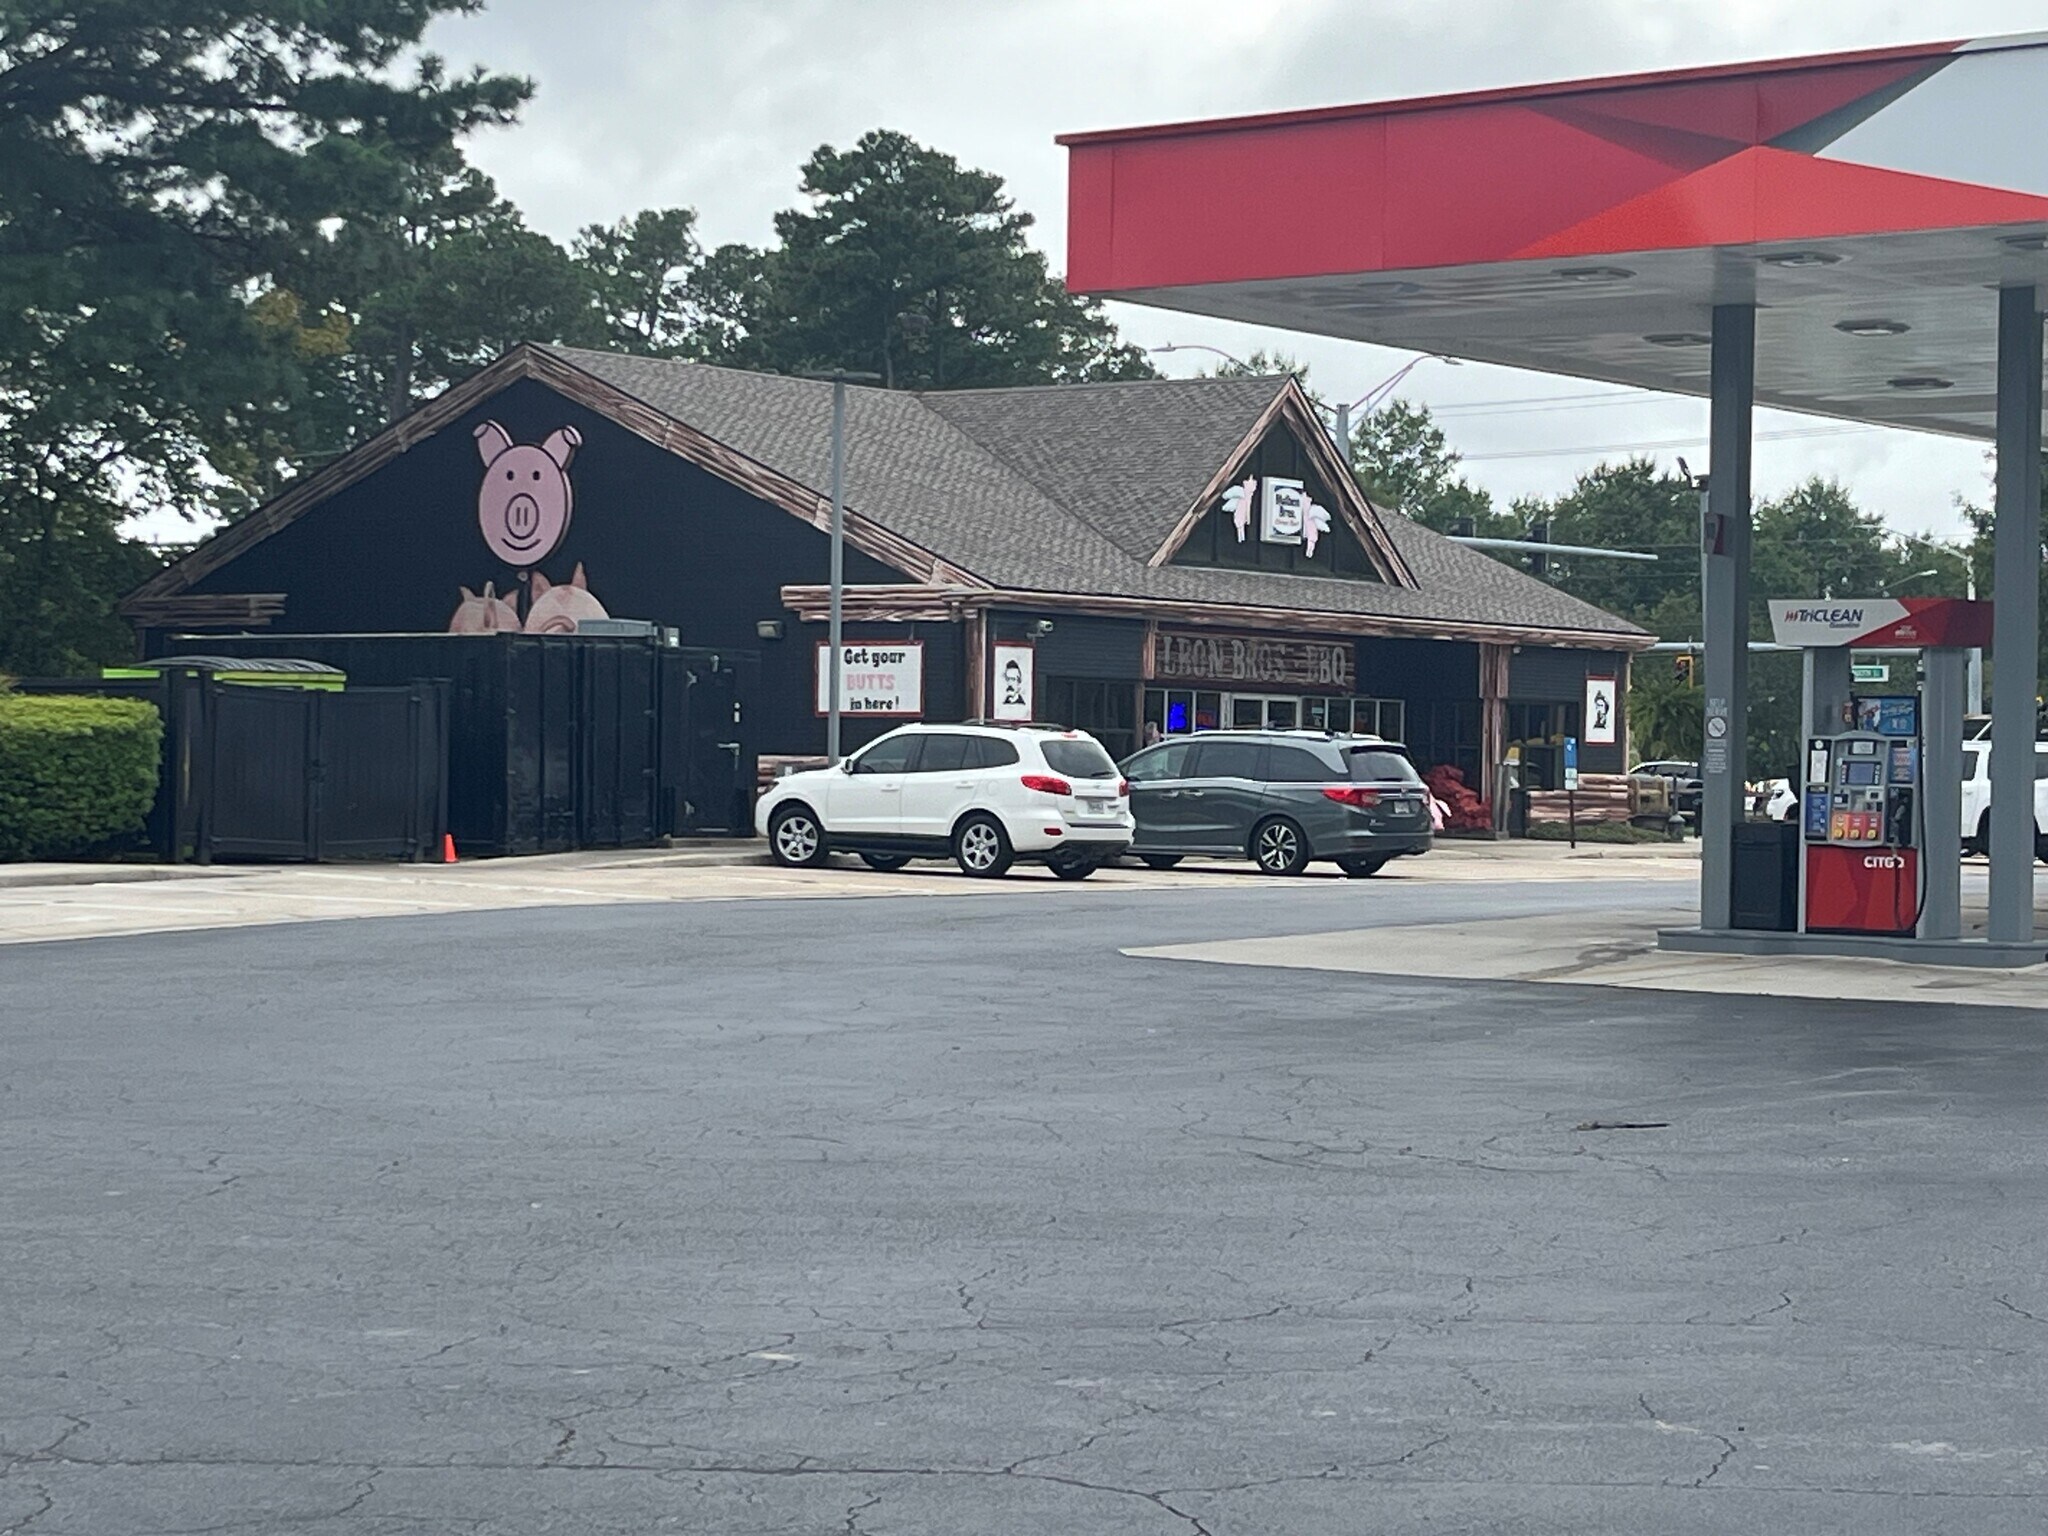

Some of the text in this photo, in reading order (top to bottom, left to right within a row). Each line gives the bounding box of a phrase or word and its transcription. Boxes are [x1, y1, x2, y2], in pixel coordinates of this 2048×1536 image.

[844, 648, 906, 668] Get your
[846, 673, 896, 691] BUTTS
[850, 696, 862, 711] in
